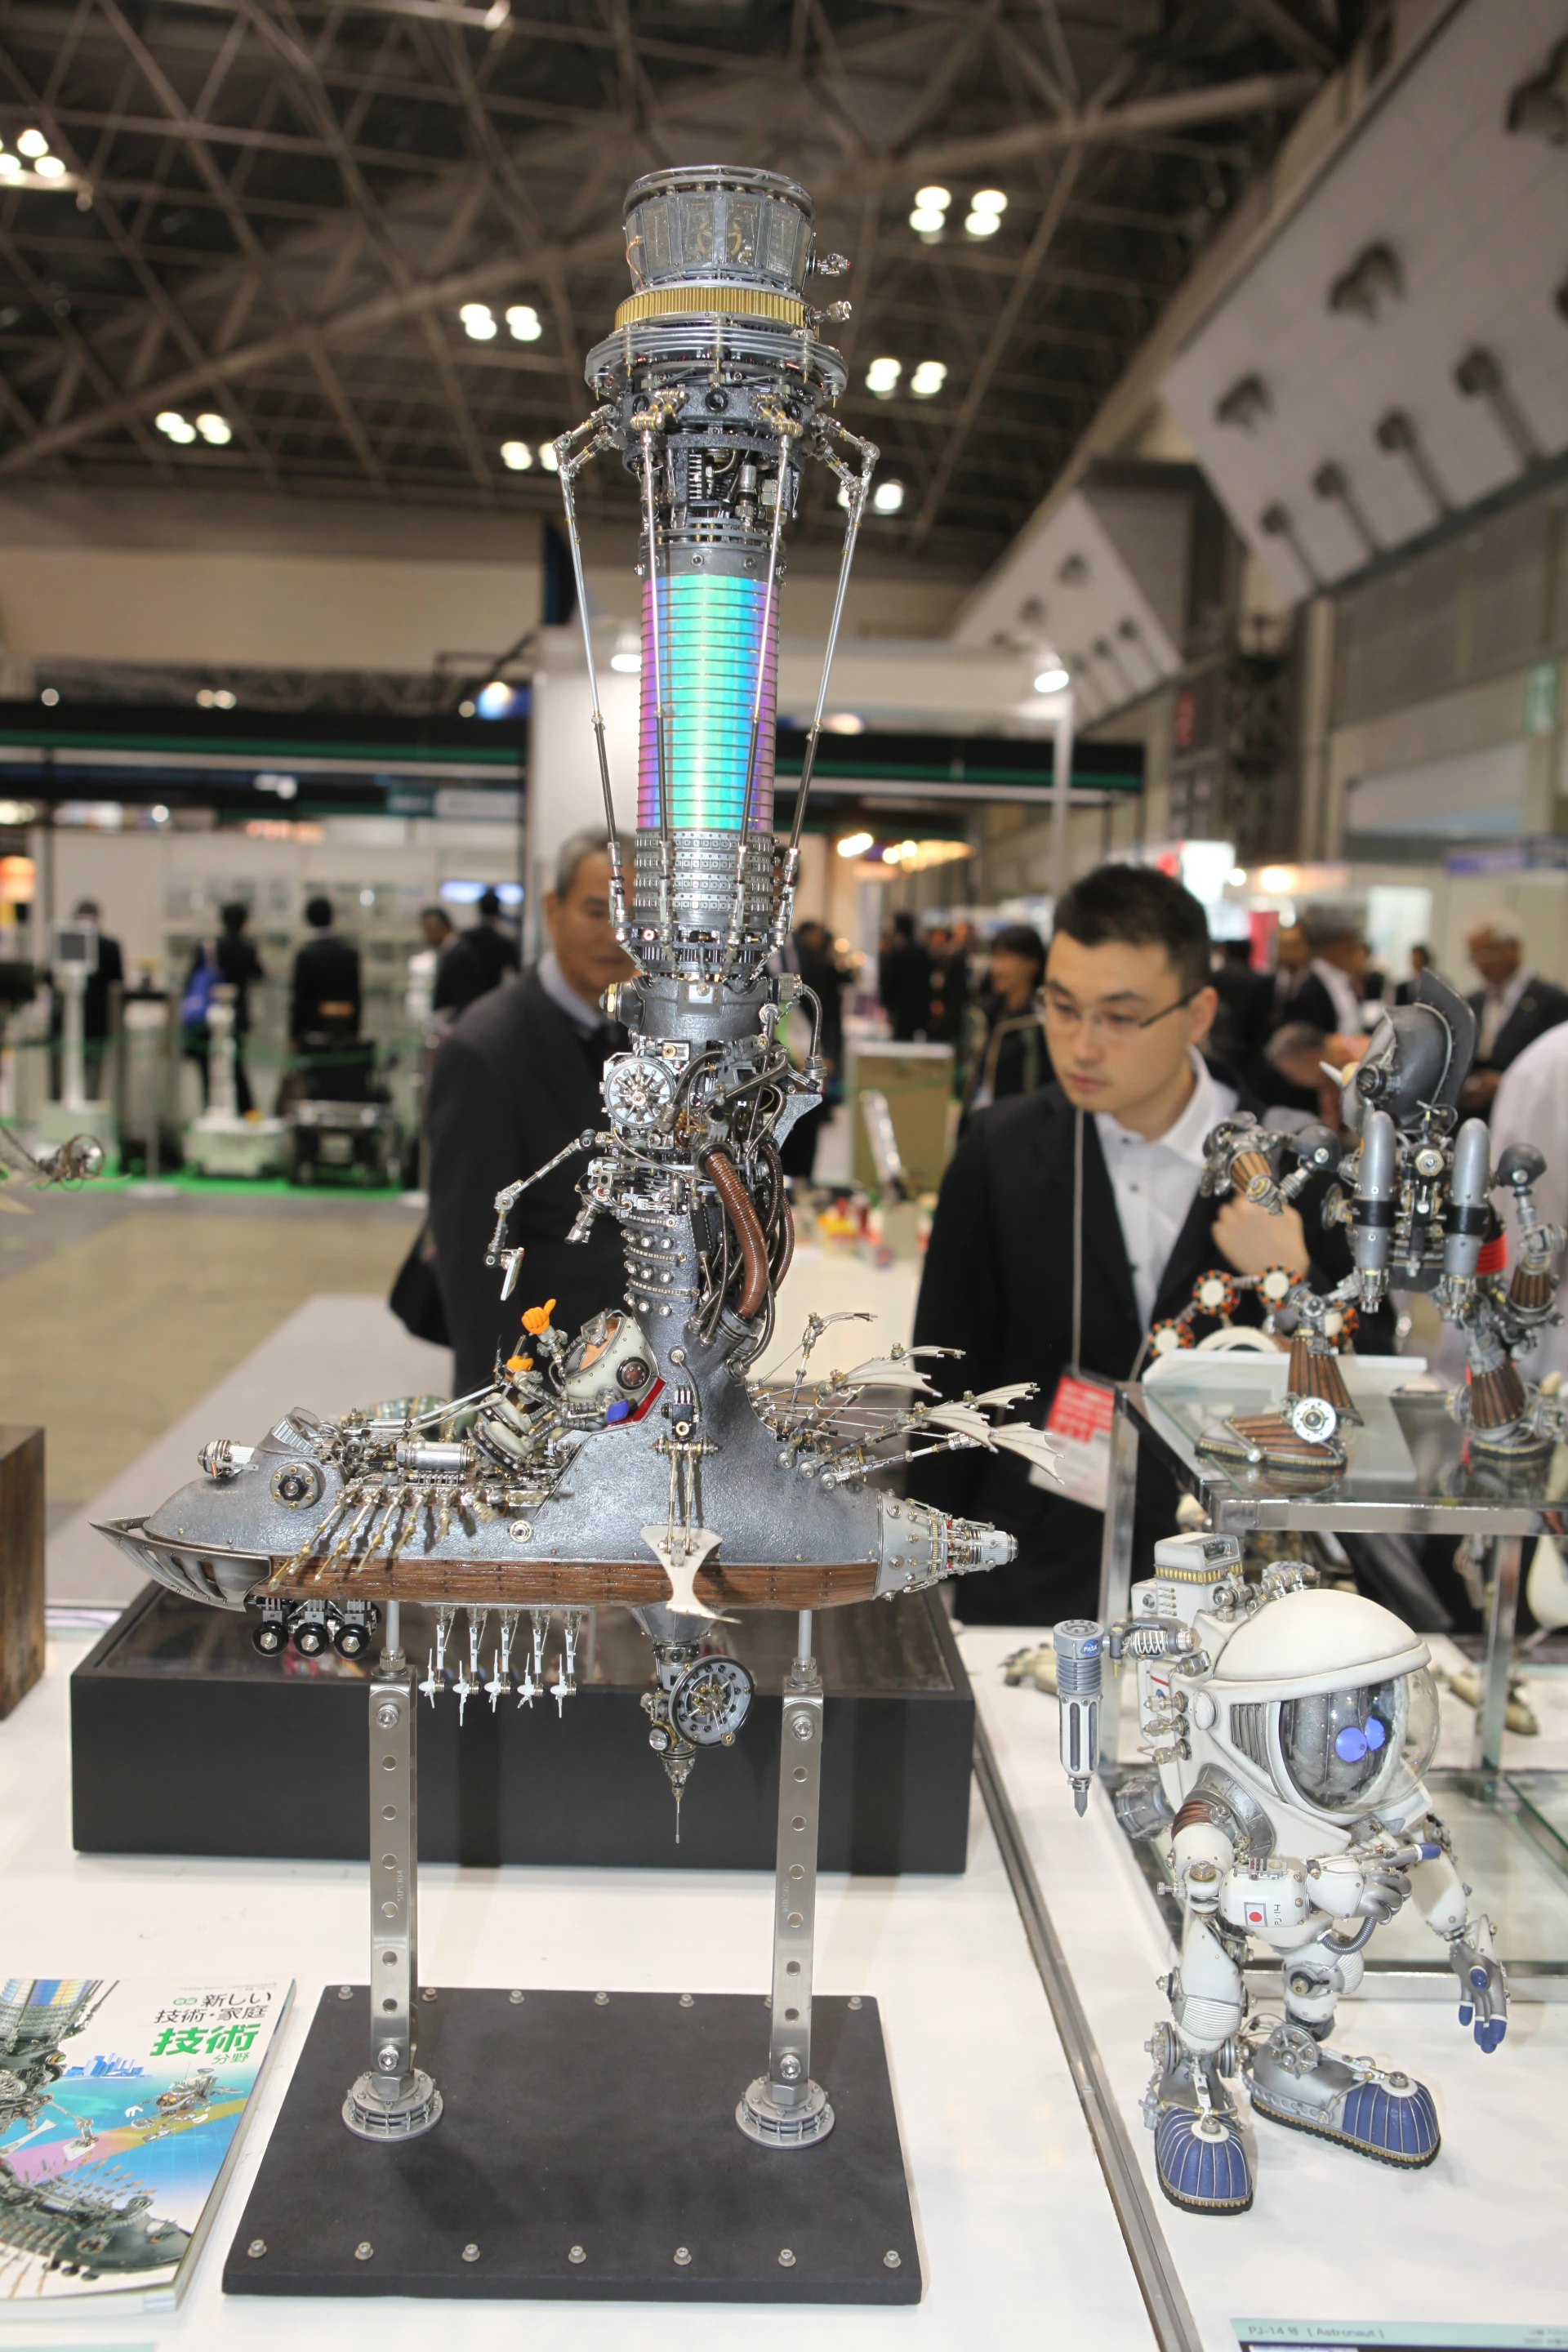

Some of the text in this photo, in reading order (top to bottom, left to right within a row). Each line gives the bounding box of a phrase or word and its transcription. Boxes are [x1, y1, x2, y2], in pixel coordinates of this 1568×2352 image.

[200, 1993, 271, 2007] 新しい
[154, 2005, 268, 2023] 技術・家庭
[149, 2024, 261, 2056] 技術
[212, 2052, 250, 2065] 分野
